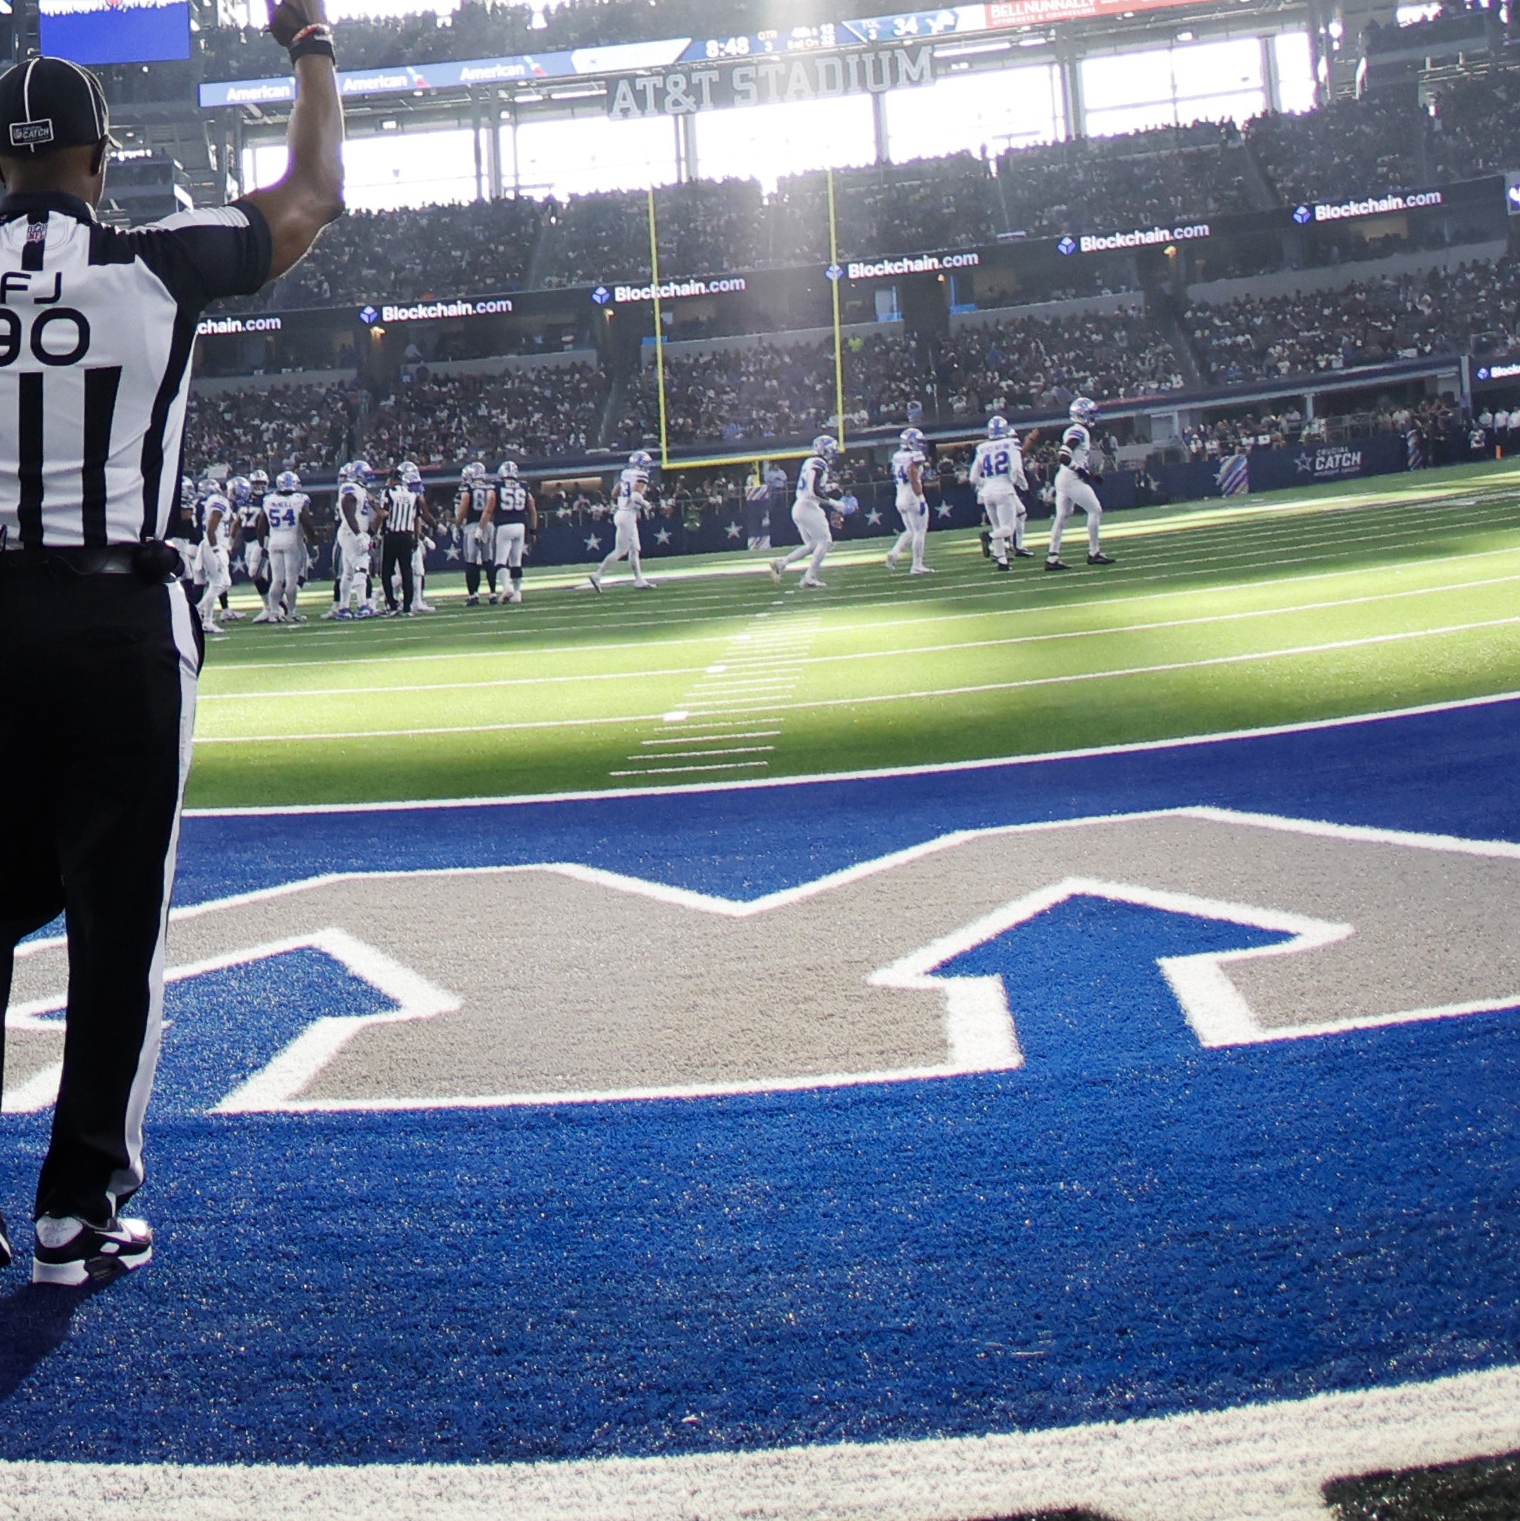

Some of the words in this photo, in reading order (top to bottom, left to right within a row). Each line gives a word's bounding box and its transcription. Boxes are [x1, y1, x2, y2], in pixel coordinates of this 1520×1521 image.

[868, 28, 877, 40] 3
[893, 16, 919, 36] 34
[705, 35, 750, 58] 8:48
[764, 40, 773, 52] 3
[459, 62, 525, 81] American
[226, 82, 291, 102] American
[342, 73, 408, 92] American
[611, 69, 720, 119] AT&T
[732, 46, 938, 108] STADIUM
[23, 126, 50, 140] CATCH
[1314, 191, 1442, 222] Blockchain.com
[1079, 223, 1210, 253] Blockchain.com
[847, 252, 980, 280] Blockchain.com
[0, 271, 63, 305] FJ
[614, 277, 747, 303] Blockchain.com
[382, 299, 513, 323] Blockchain.com
[979, 450, 1011, 478] 42
[1314, 451, 1363, 471] CATCH
[268, 509, 297, 528] 54
